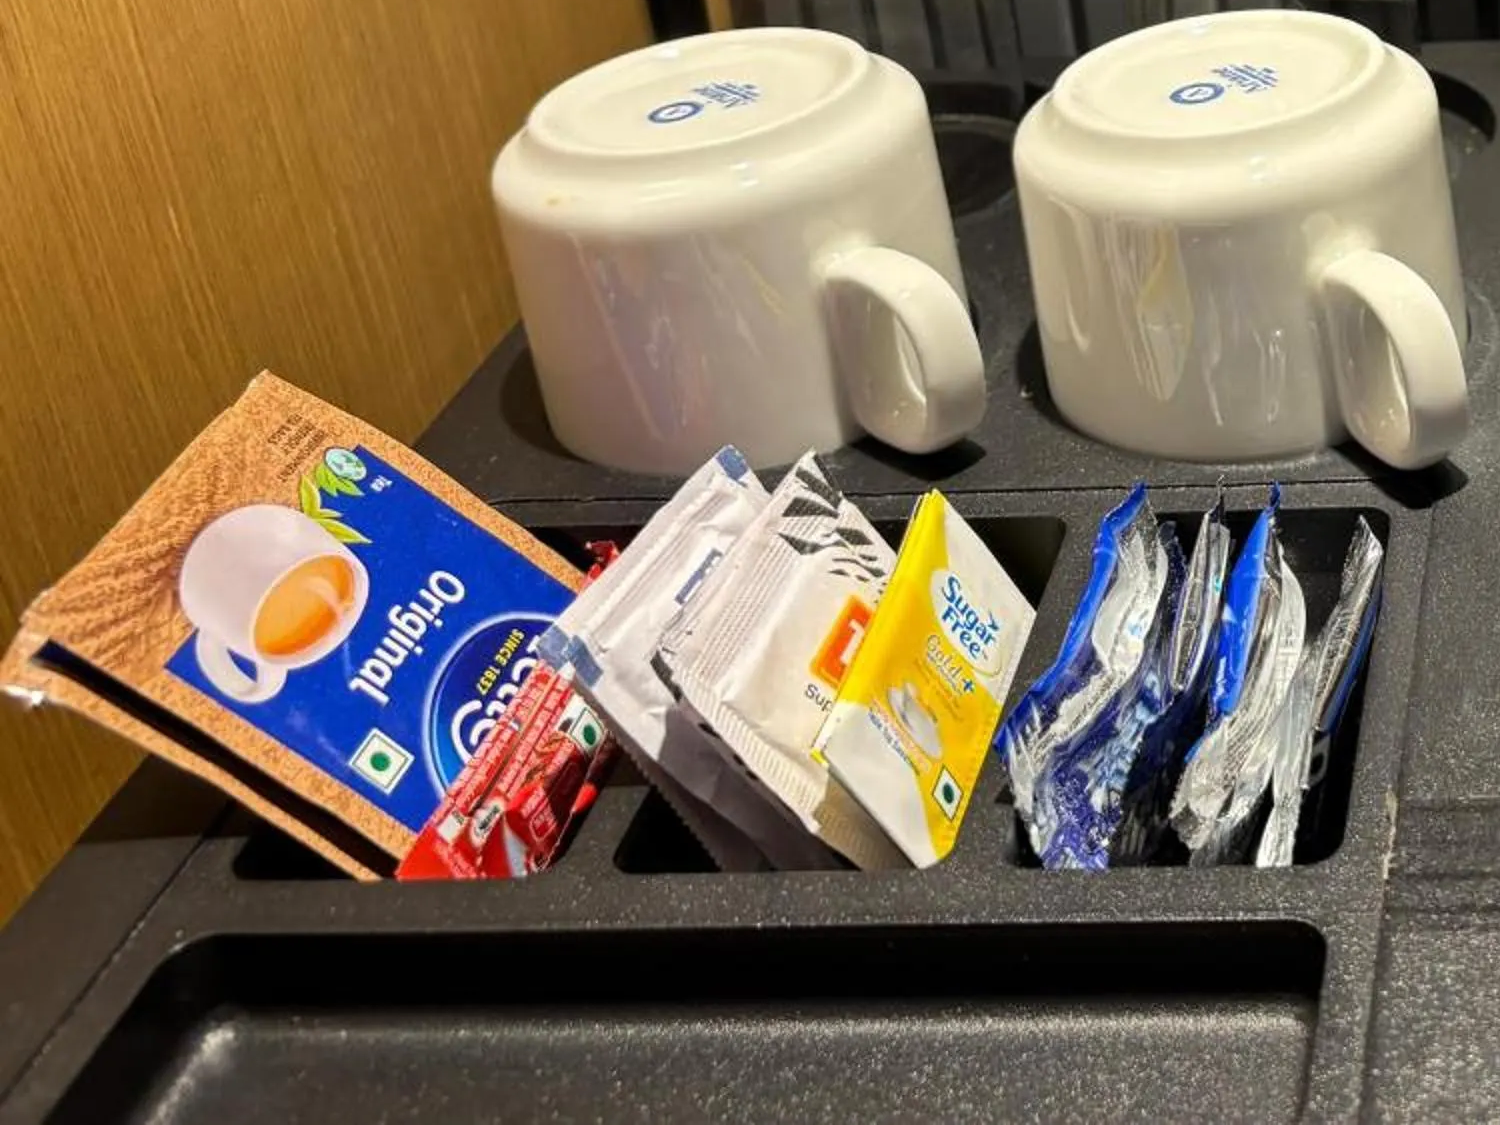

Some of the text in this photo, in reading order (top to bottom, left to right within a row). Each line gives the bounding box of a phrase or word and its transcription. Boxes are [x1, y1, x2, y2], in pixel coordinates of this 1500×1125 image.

[348, 570, 465, 706] Original
[941, 576, 997, 646] Sugar
[941, 606, 981, 660] Free
[476, 628, 524, 695] SINCE 1837
